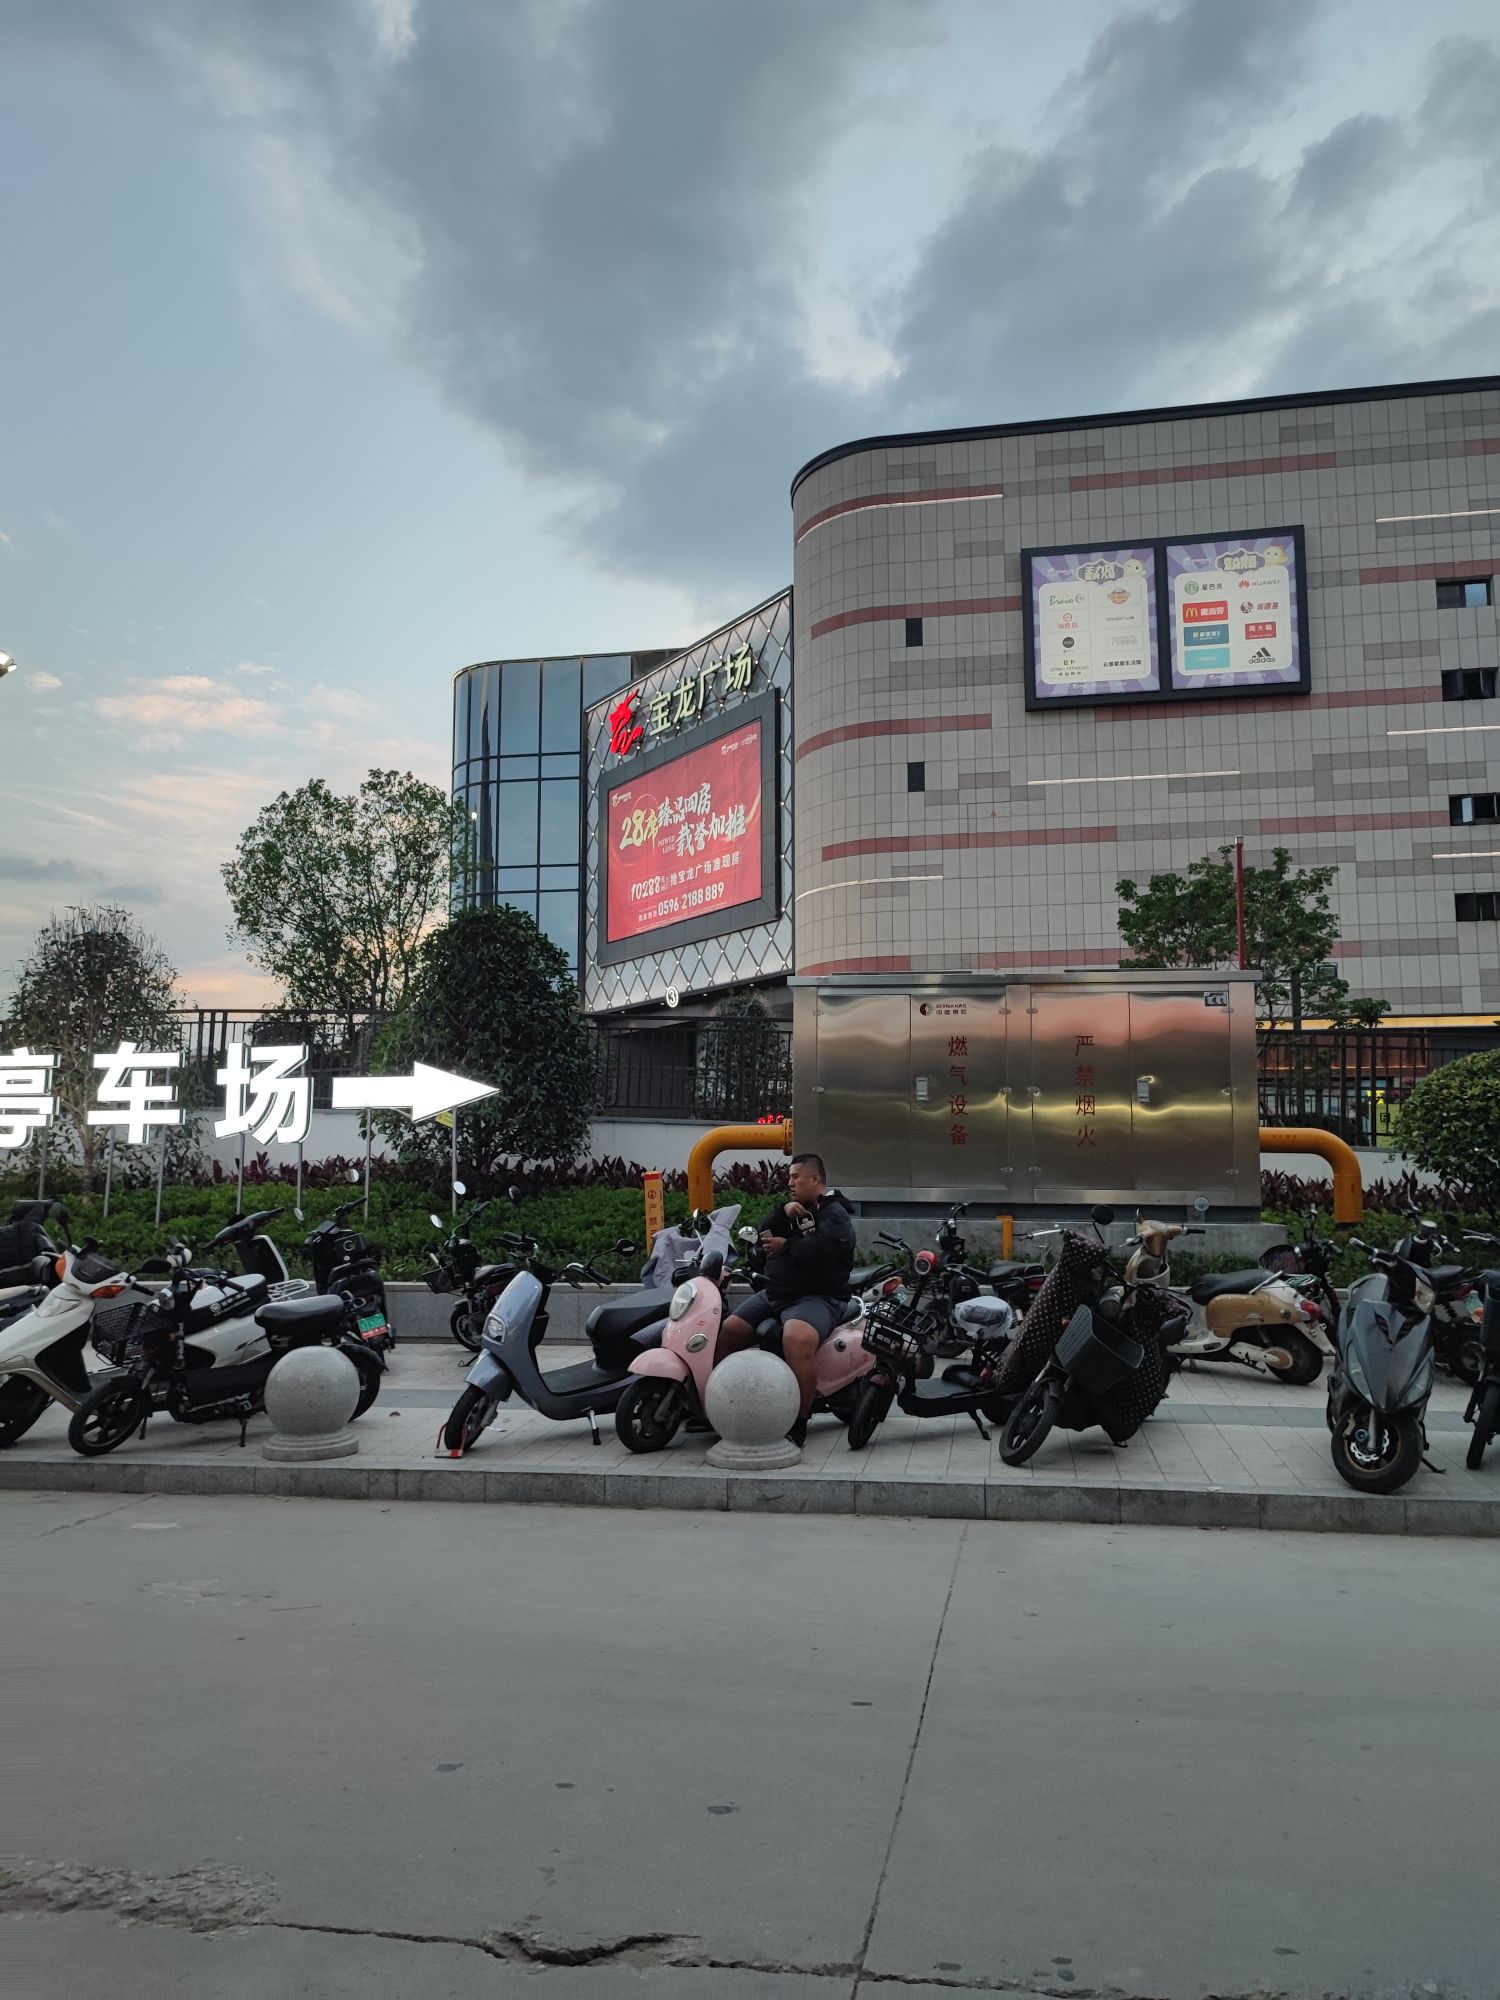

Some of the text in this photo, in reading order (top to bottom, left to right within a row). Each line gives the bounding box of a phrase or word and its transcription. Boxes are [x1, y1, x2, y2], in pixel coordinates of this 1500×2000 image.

[1202, 583, 1223, 591] 星巴克
[1252, 579, 1280, 587] HUAWEI
[1248, 657, 1276, 665] adidas
[650, 643, 752, 736] 宝龙广场
[630, 875, 661, 901] 10288
[947, 1035, 969, 1146] 燃气设备
[1074, 1035, 1096, 1146] 严禁烟火
